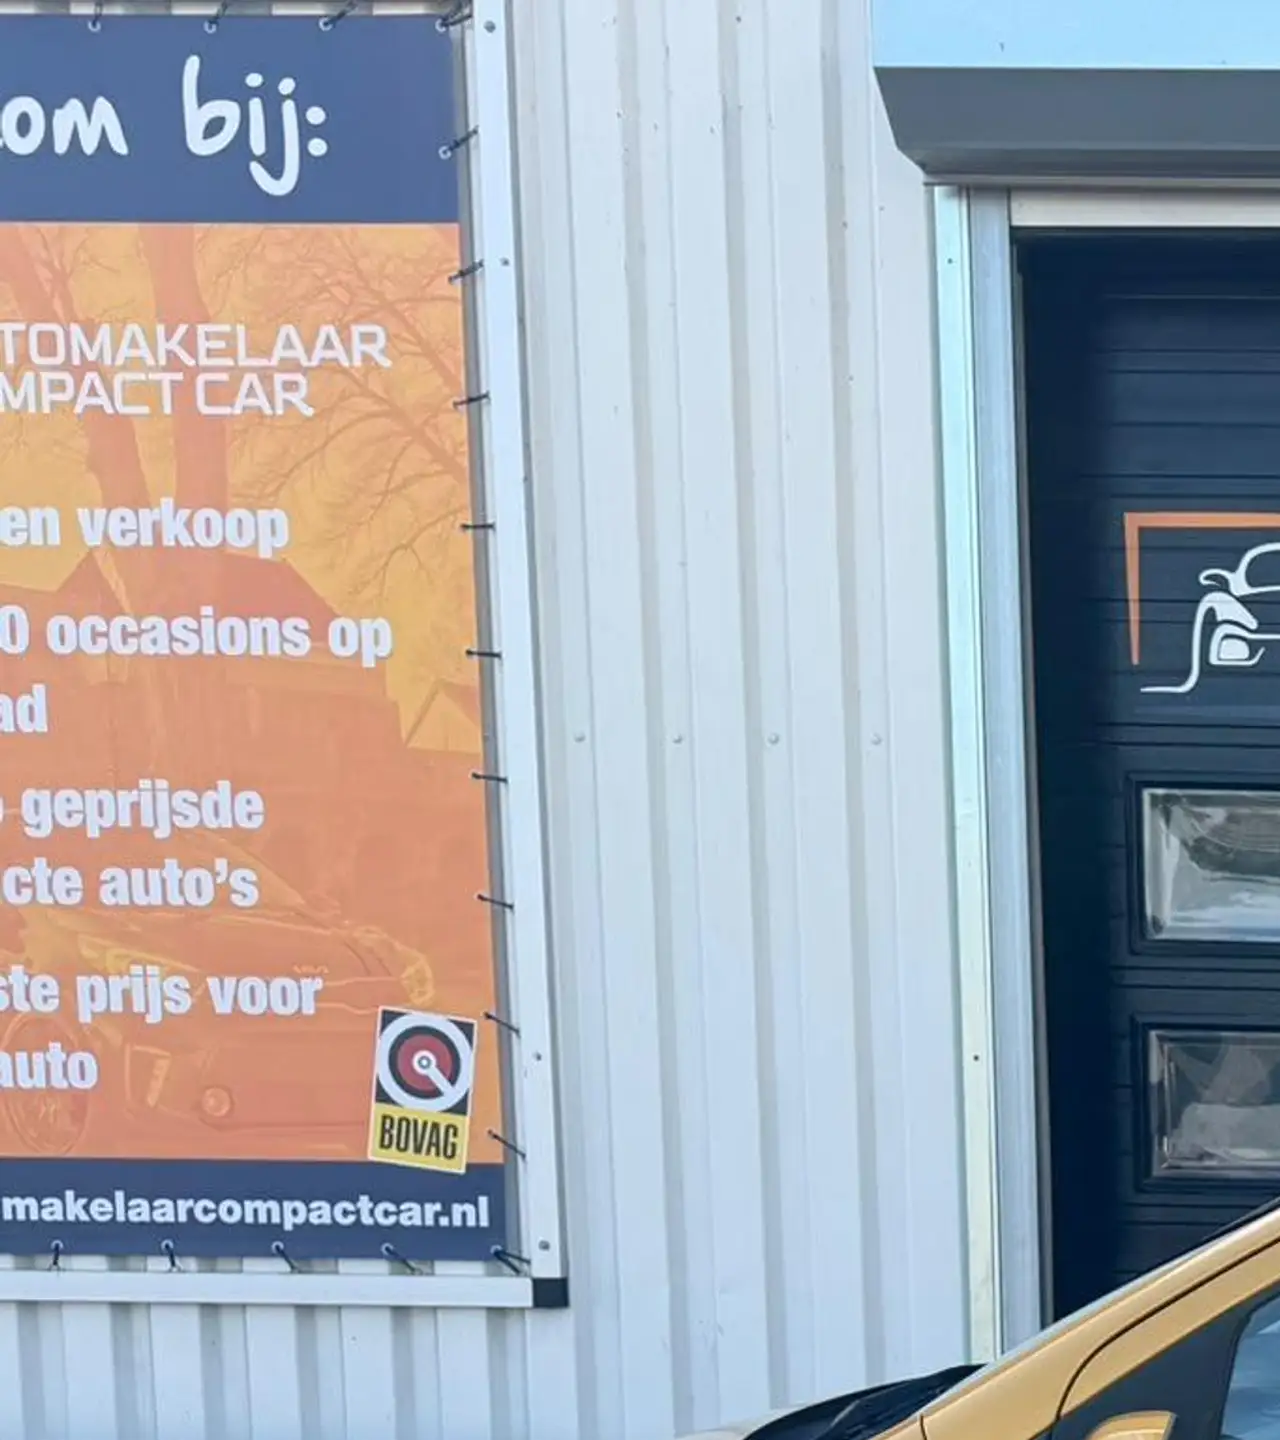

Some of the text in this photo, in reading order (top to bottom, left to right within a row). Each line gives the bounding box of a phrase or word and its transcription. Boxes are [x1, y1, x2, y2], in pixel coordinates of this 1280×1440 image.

[0, 55, 328, 196] om bij:
[0, 322, 392, 368] TOMAKELAAR
[0, 370, 315, 417] MPACT CAR
[0, 497, 290, 559] en verkoop
[46, 605, 312, 657] occasions
[328, 617, 393, 668] op
[21, 779, 264, 840] geprijsde
[3, 857, 259, 907] cte auto's
[76, 965, 193, 1024] prijs
[206, 976, 324, 1016] voor
[379, 1114, 459, 1160] BOVAG
[2, 1189, 489, 1231] makelaarcompactcar.nl
